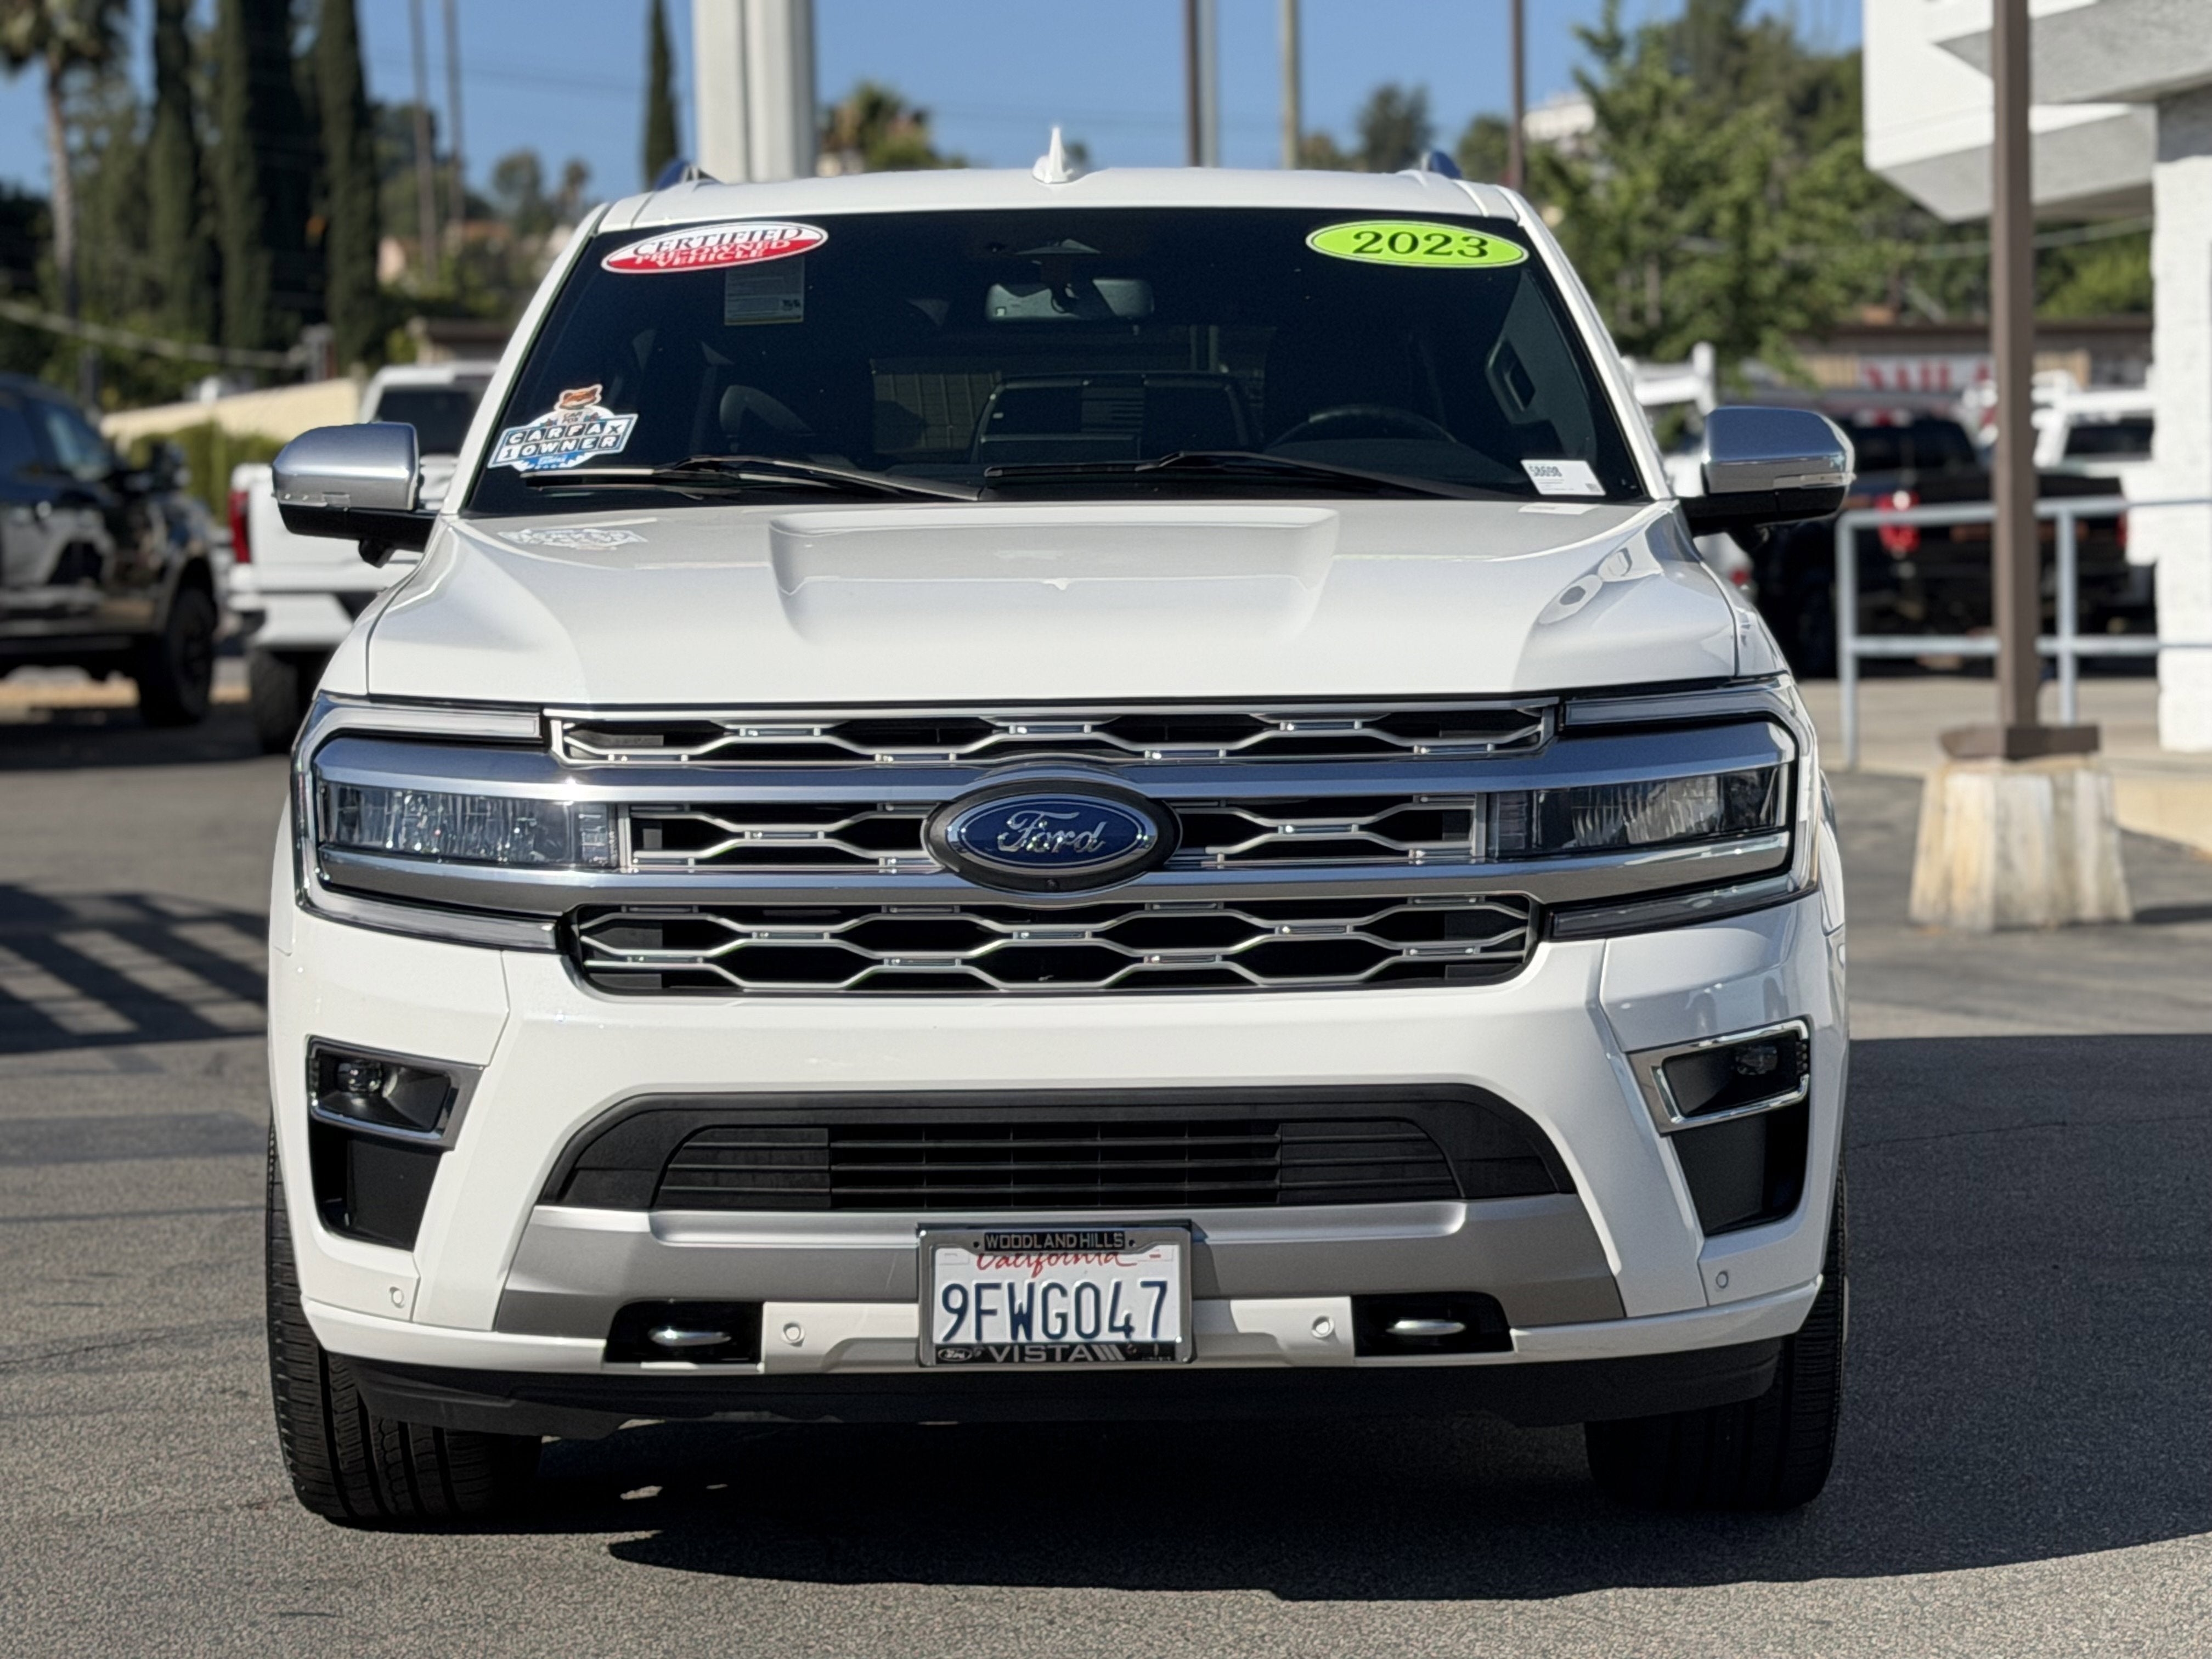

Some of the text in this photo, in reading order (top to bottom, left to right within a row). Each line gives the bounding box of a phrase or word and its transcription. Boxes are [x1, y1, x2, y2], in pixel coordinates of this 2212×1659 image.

[634, 228, 802, 256] CERTIFIED
[635, 239, 791, 264] PRE-OWNED
[1352, 230, 1488, 258] 2023
[656, 247, 765, 267] VEHICLE
[509, 423, 622, 444] CARFAX
[503, 436, 617, 459] 1 OWNER
[997, 810, 1107, 853] Ford
[985, 1232, 1124, 1249] WOODLAND HILLS
[976, 1251, 1138, 1278] California
[941, 1280, 1168, 1342] 9FWG047
[990, 1345, 1096, 1363] VISTA
